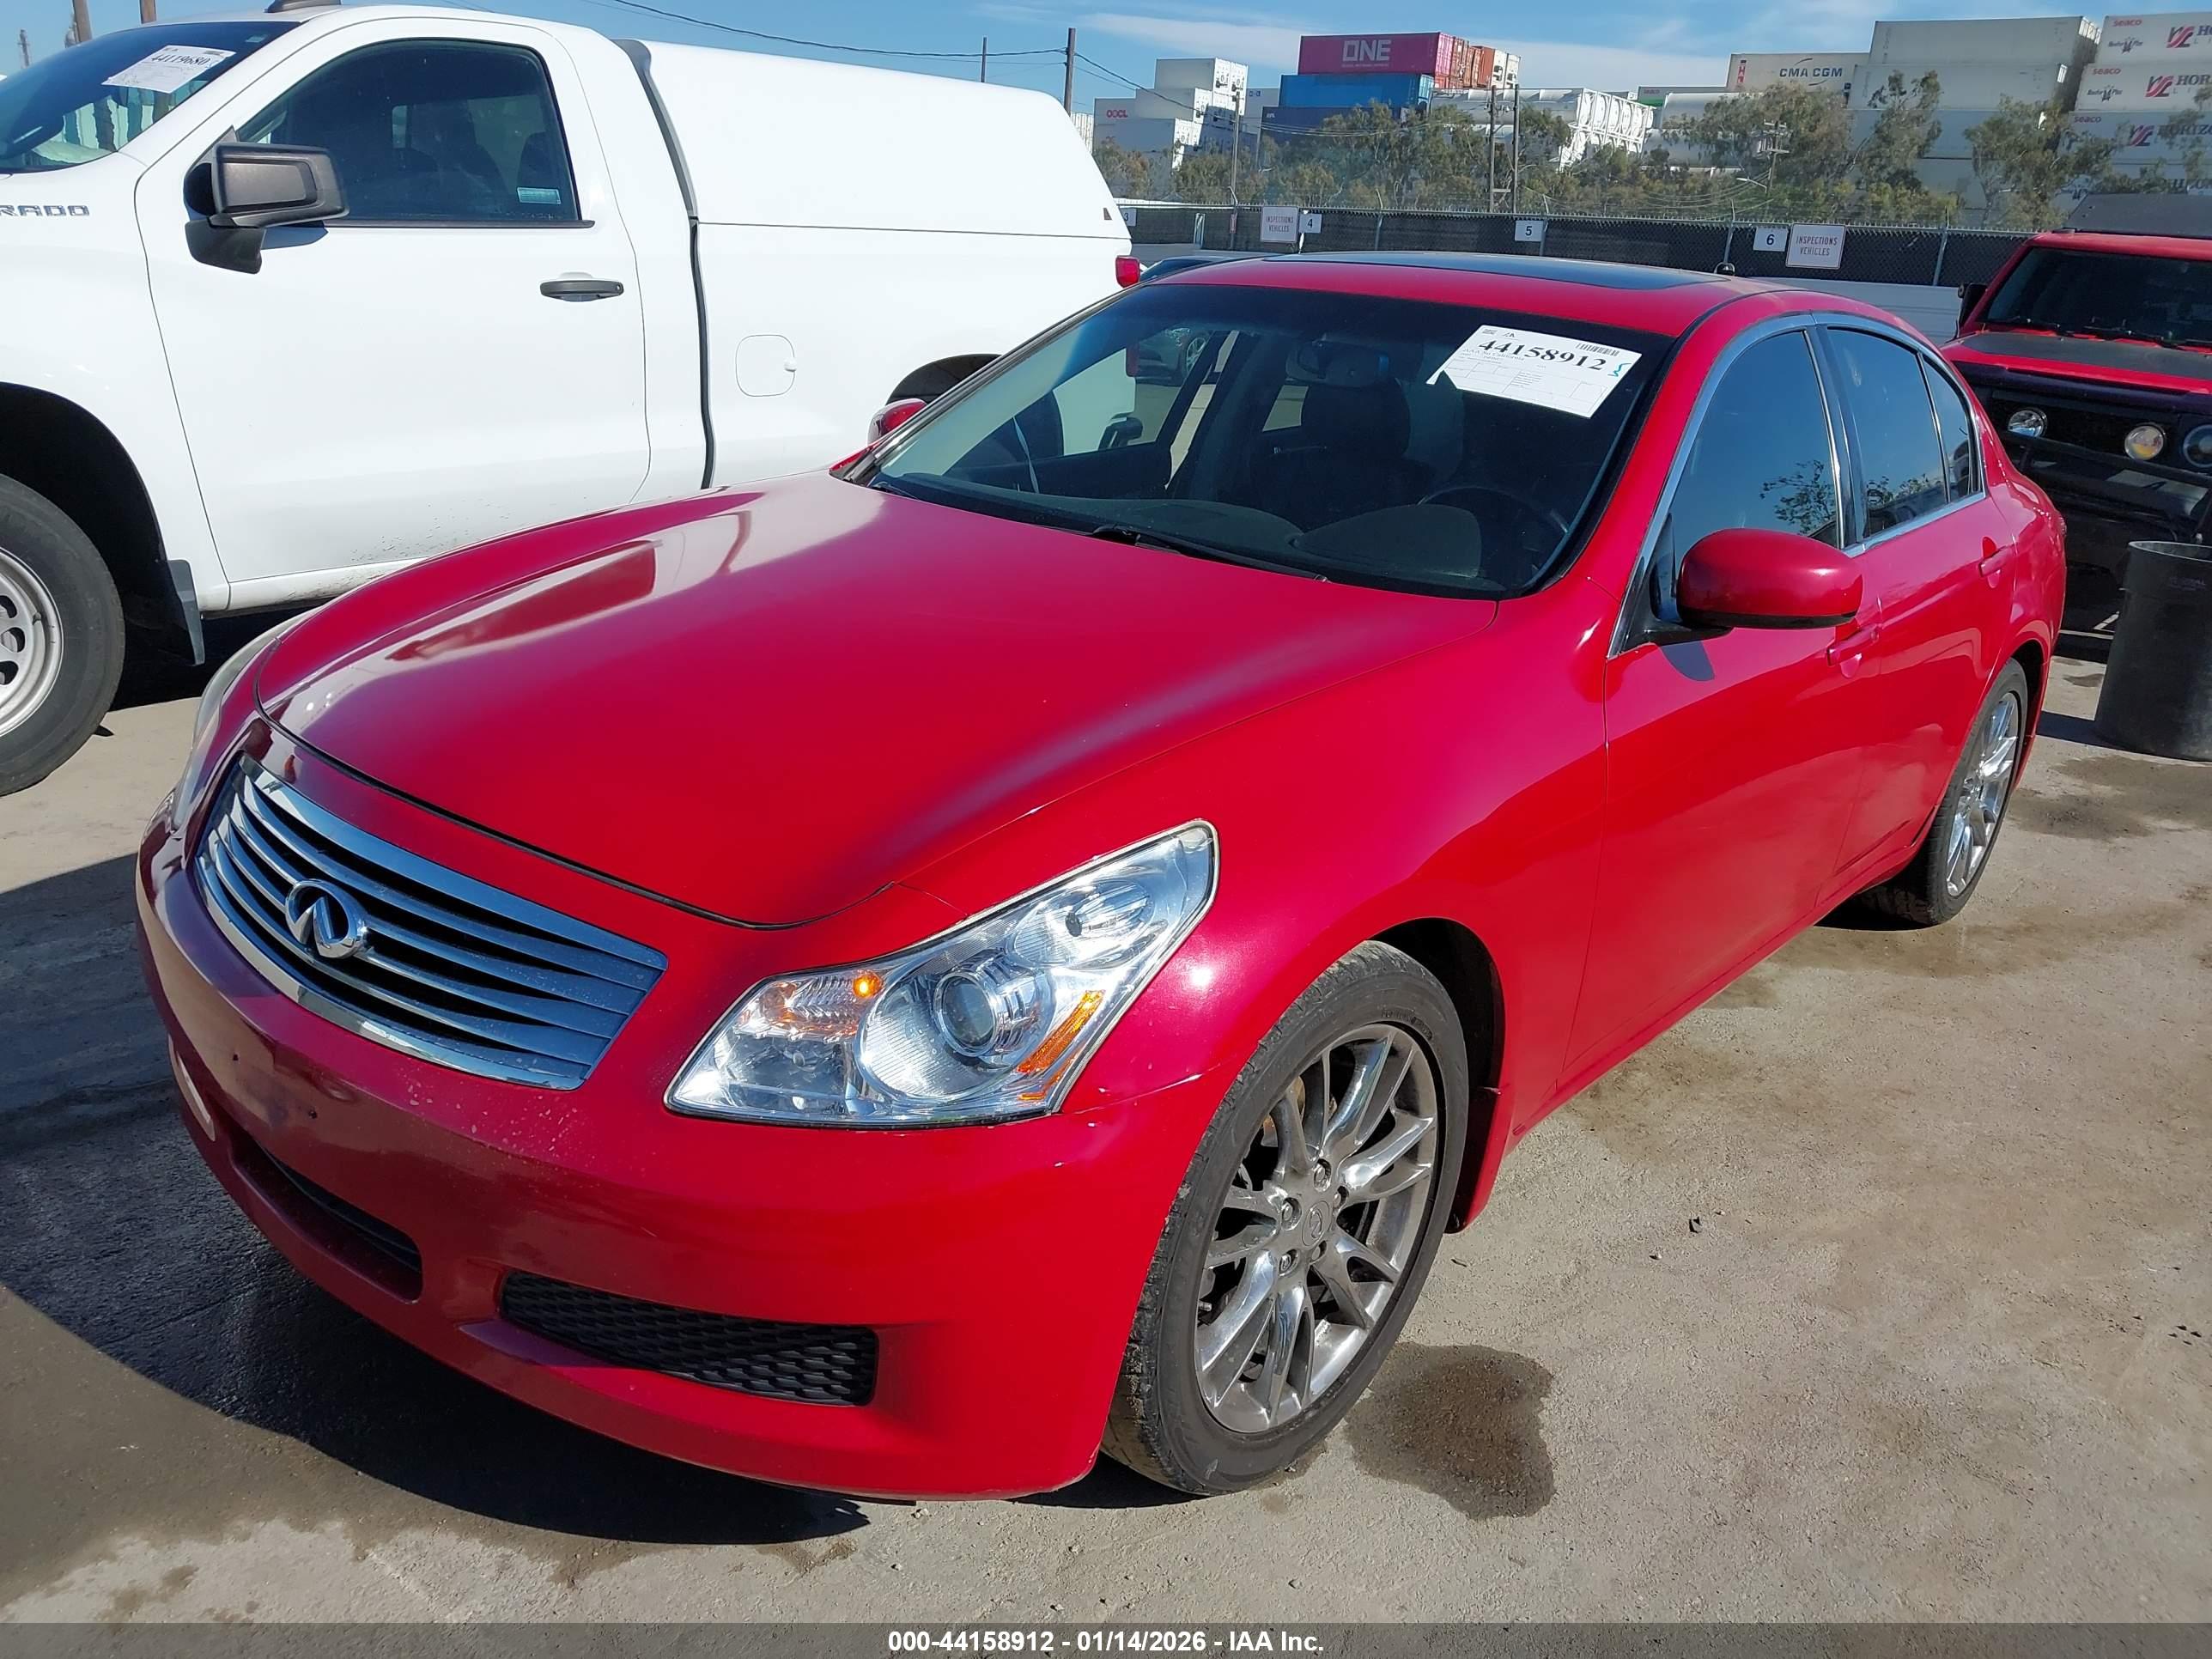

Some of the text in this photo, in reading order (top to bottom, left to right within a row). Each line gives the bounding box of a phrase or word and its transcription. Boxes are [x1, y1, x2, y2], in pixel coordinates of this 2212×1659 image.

[1343, 40, 1391, 61] ONE
[151, 53, 212, 65] 44119680
[1779, 68, 1843, 77] CMA CGM
[1106, 109, 1127, 118] OOCL
[1124, 212, 1129, 221] 3
[1307, 218, 1313, 228] 4
[1525, 226, 1533, 236] 5
[1766, 234, 1775, 246] 6
[1796, 235, 1838, 246] INSPECTIONS
[1800, 246, 1831, 256] VEHICLES
[1479, 339, 1607, 371] 44158912
